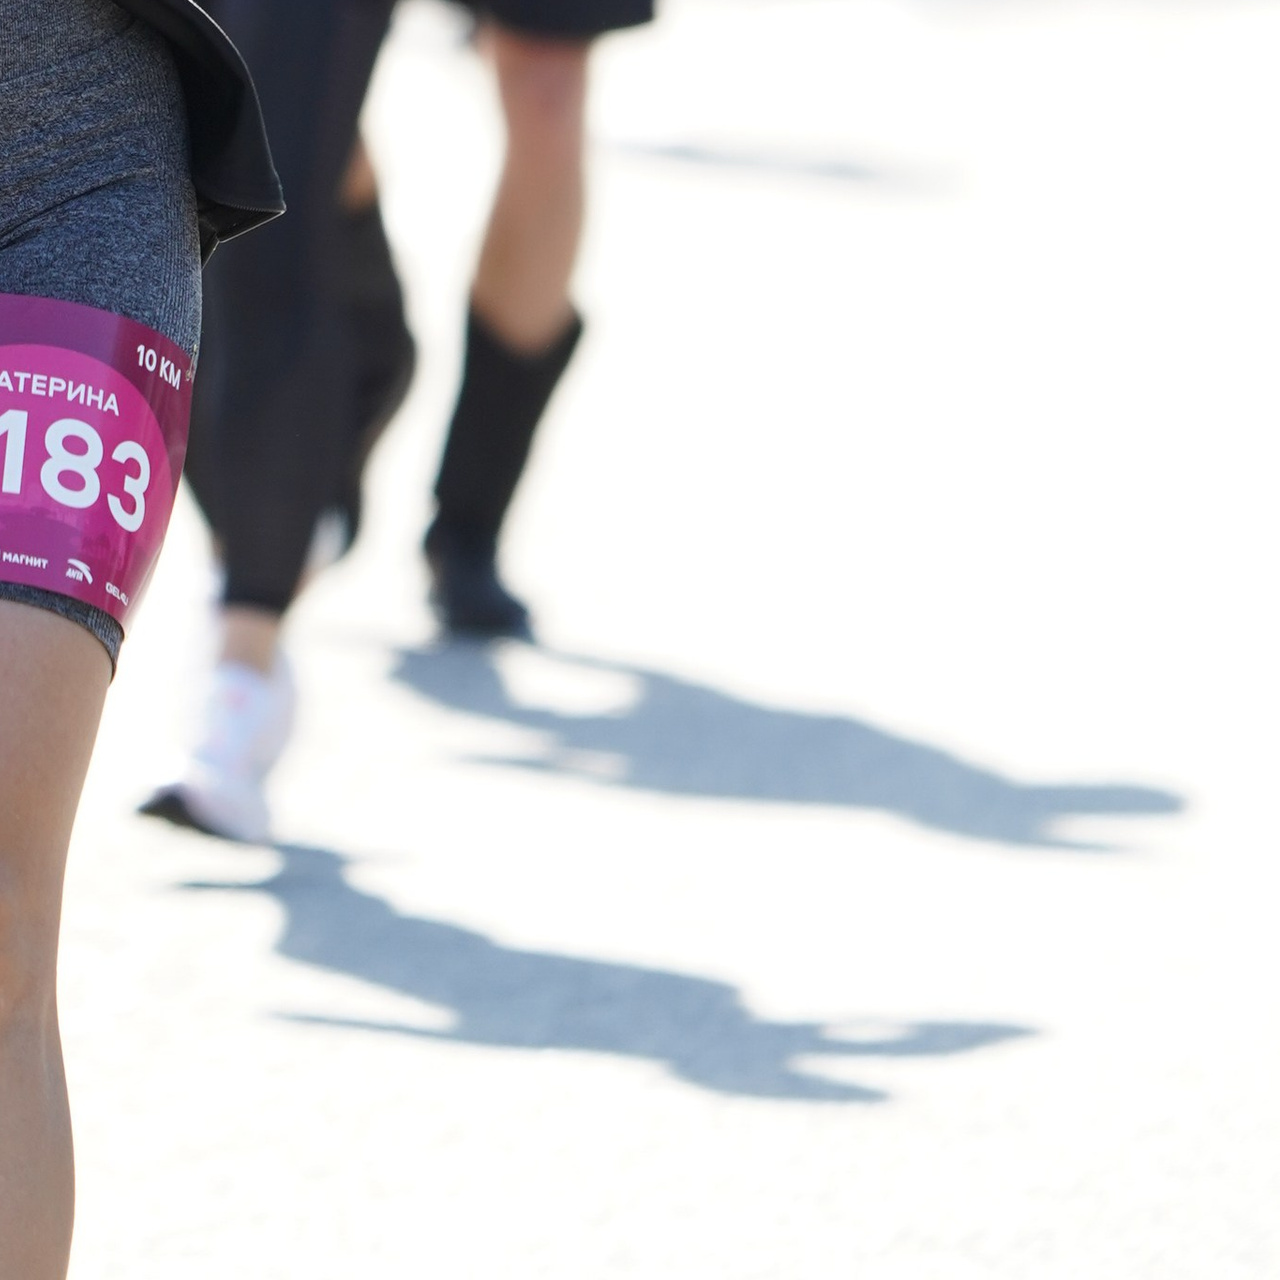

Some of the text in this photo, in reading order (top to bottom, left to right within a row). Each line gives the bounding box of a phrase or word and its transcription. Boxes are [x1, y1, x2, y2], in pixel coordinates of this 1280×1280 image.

[137, 344, 182, 391] 10 KM
[2, 551, 49, 569] МАГНИТ
